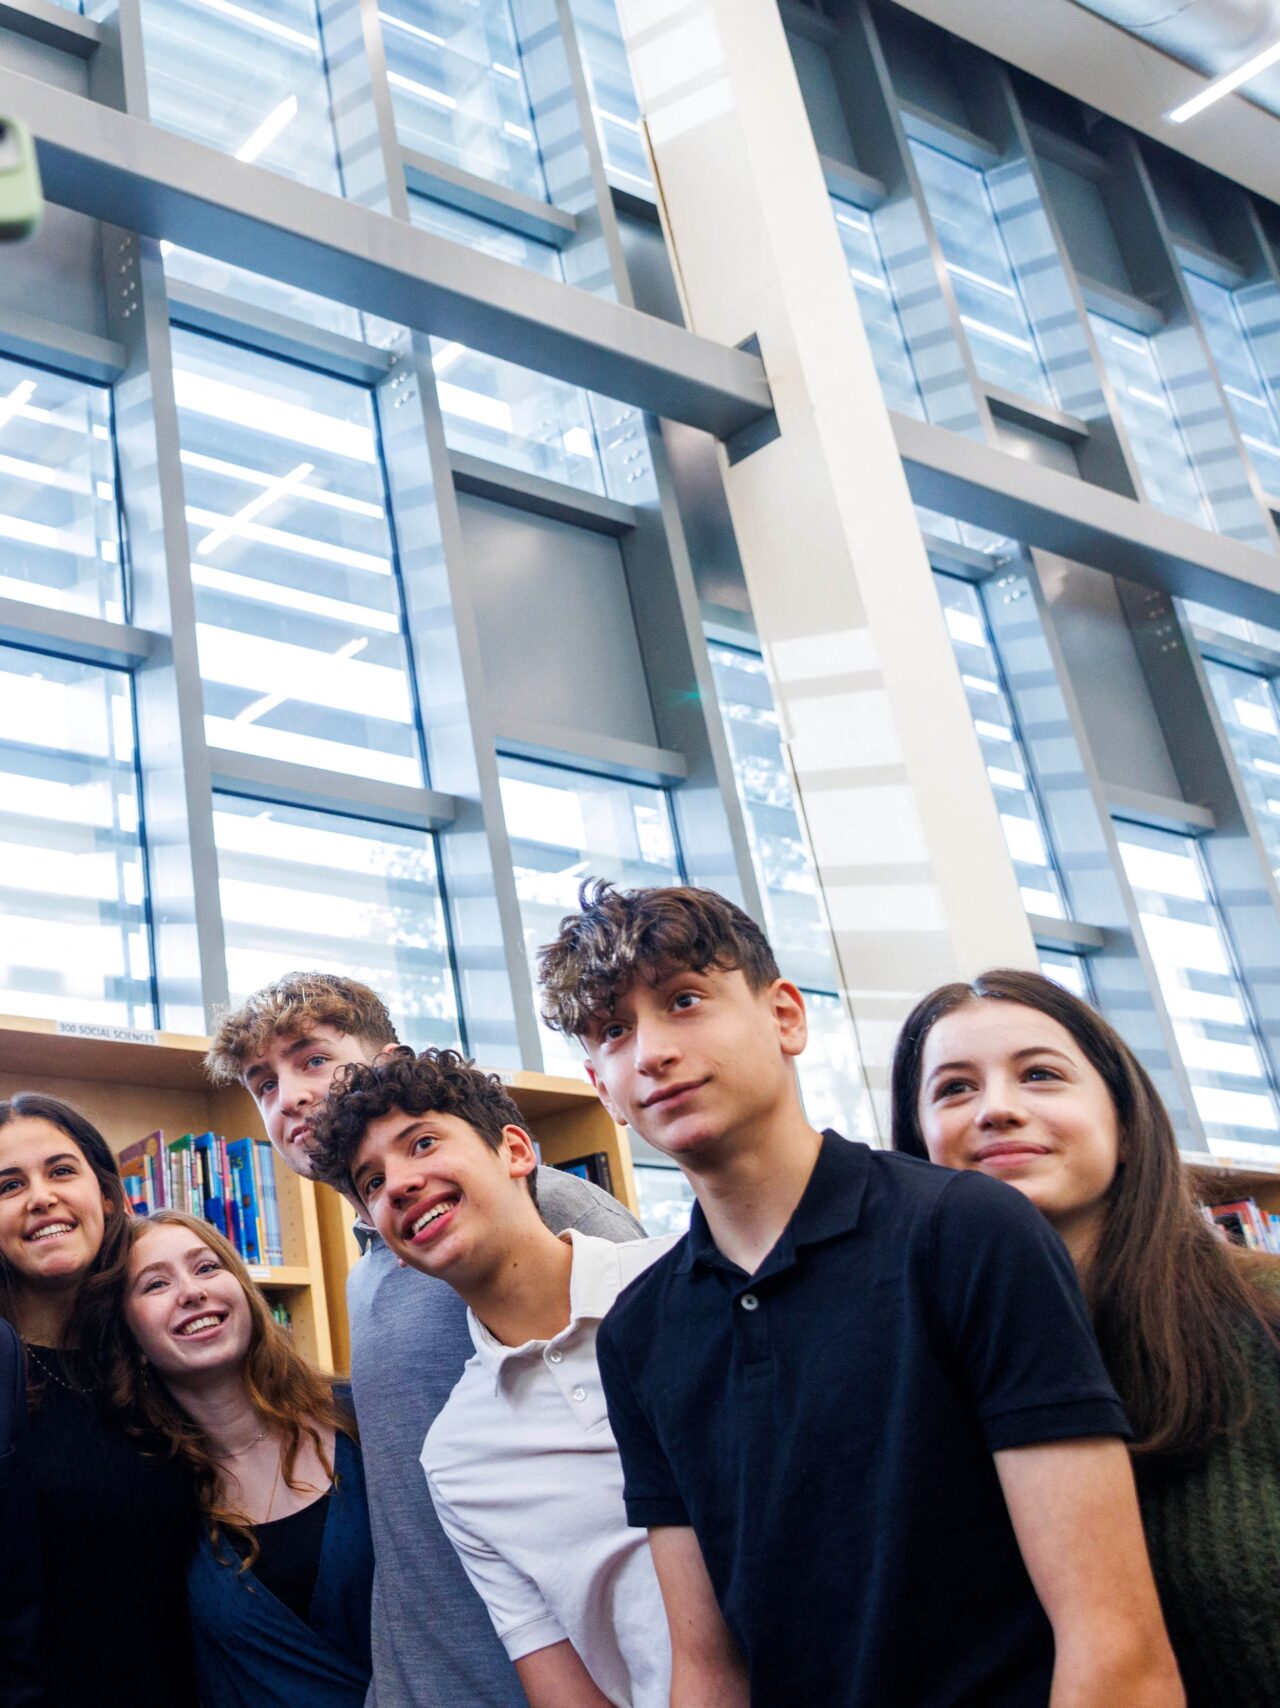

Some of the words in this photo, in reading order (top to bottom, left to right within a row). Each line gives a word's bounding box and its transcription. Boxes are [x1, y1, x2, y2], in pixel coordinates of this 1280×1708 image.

[60, 1023, 76, 1033] 300
[79, 1025, 110, 1038] SOCIAL
[113, 1029, 155, 1044] SCIENCES
